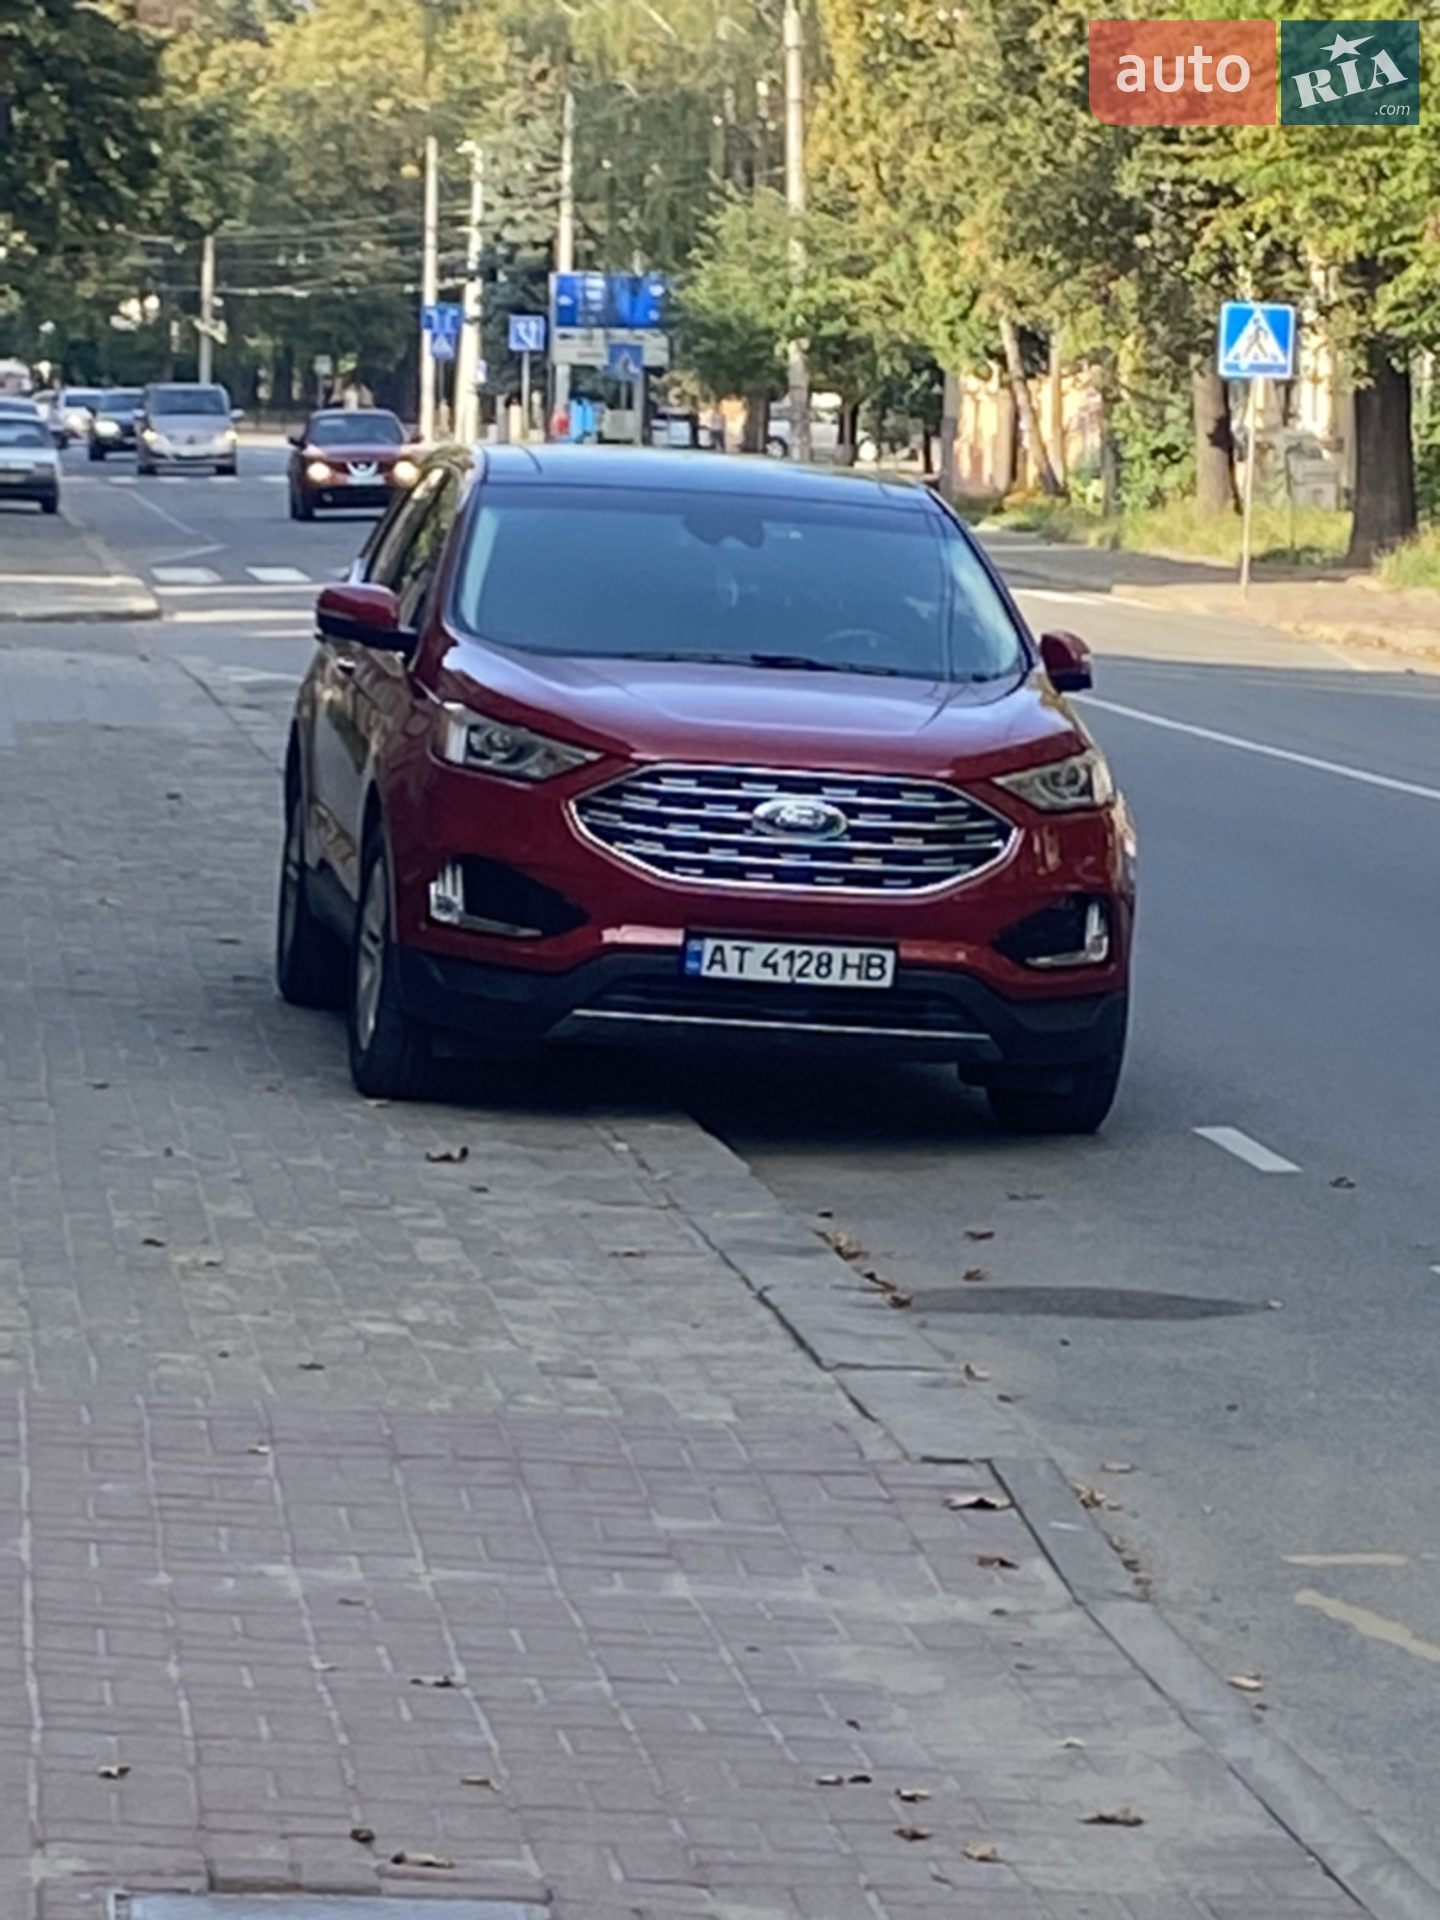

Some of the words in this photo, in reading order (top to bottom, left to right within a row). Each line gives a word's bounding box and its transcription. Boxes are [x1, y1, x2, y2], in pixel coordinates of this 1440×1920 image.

[706, 944, 754, 974] AT
[760, 948, 833, 980] 4128
[838, 952, 887, 982] HB
